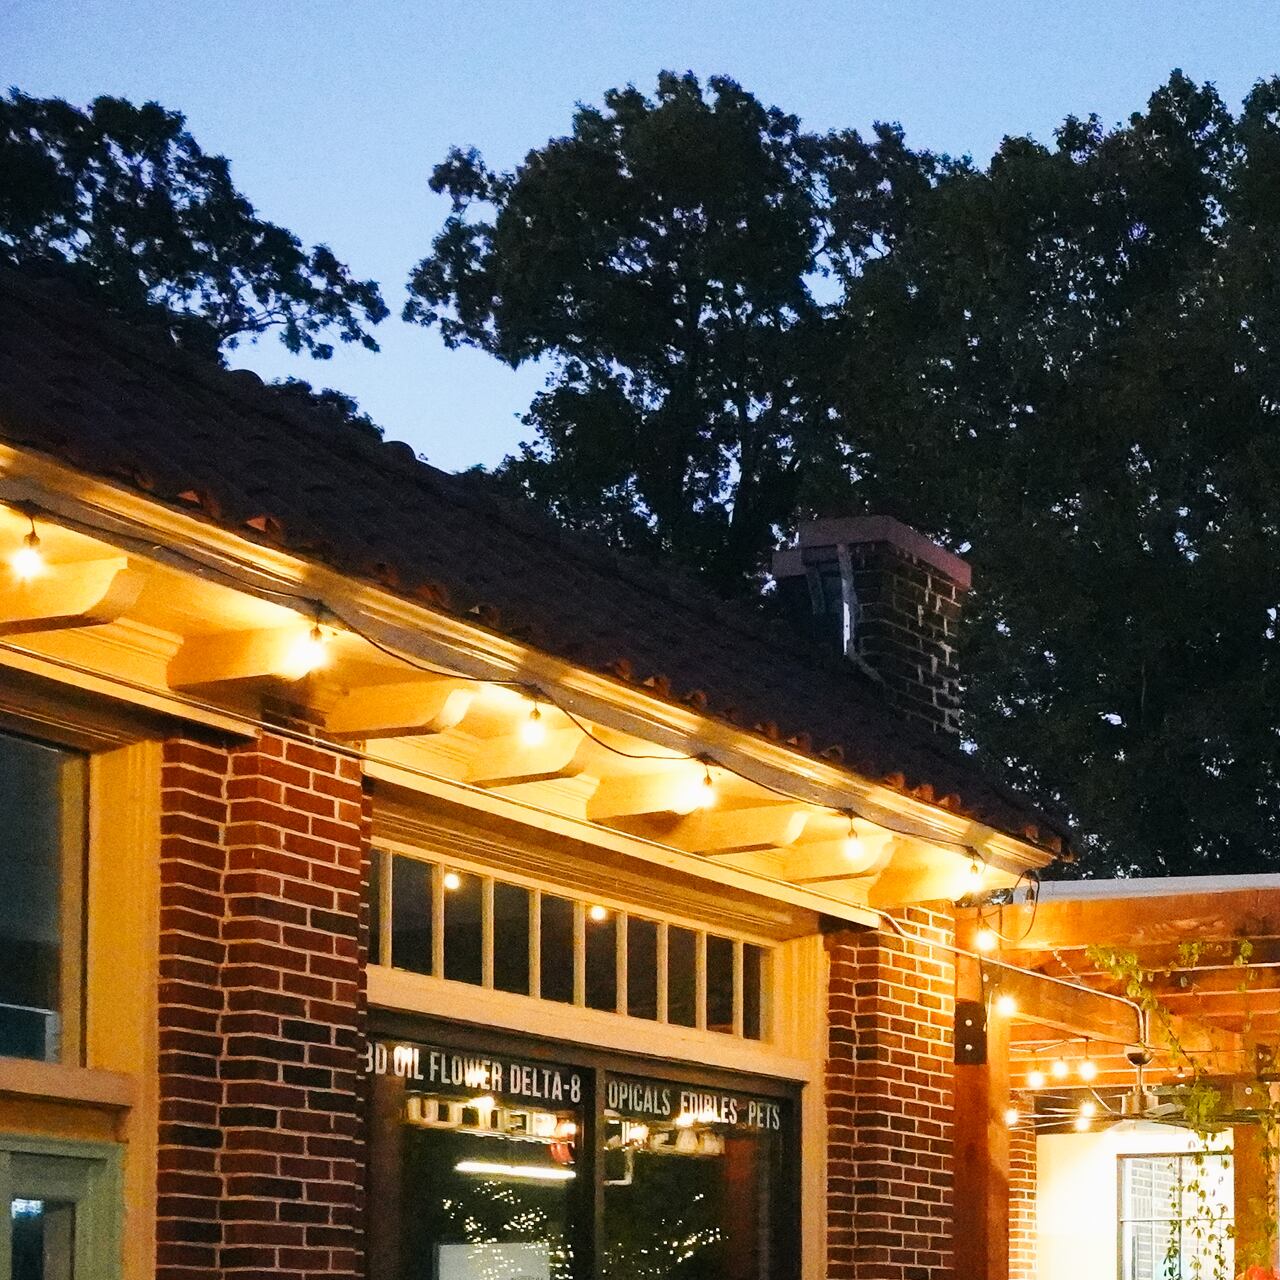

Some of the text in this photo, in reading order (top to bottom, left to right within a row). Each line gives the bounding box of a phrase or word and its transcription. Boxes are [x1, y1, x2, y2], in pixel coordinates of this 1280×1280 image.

[393, 1045, 424, 1081] OIL
[429, 1051, 503, 1092] FLOWER
[509, 1063, 582, 1104] DELTA-8
[680, 1091, 738, 1125] EDIBLES
[747, 1101, 780, 1131] PETS
